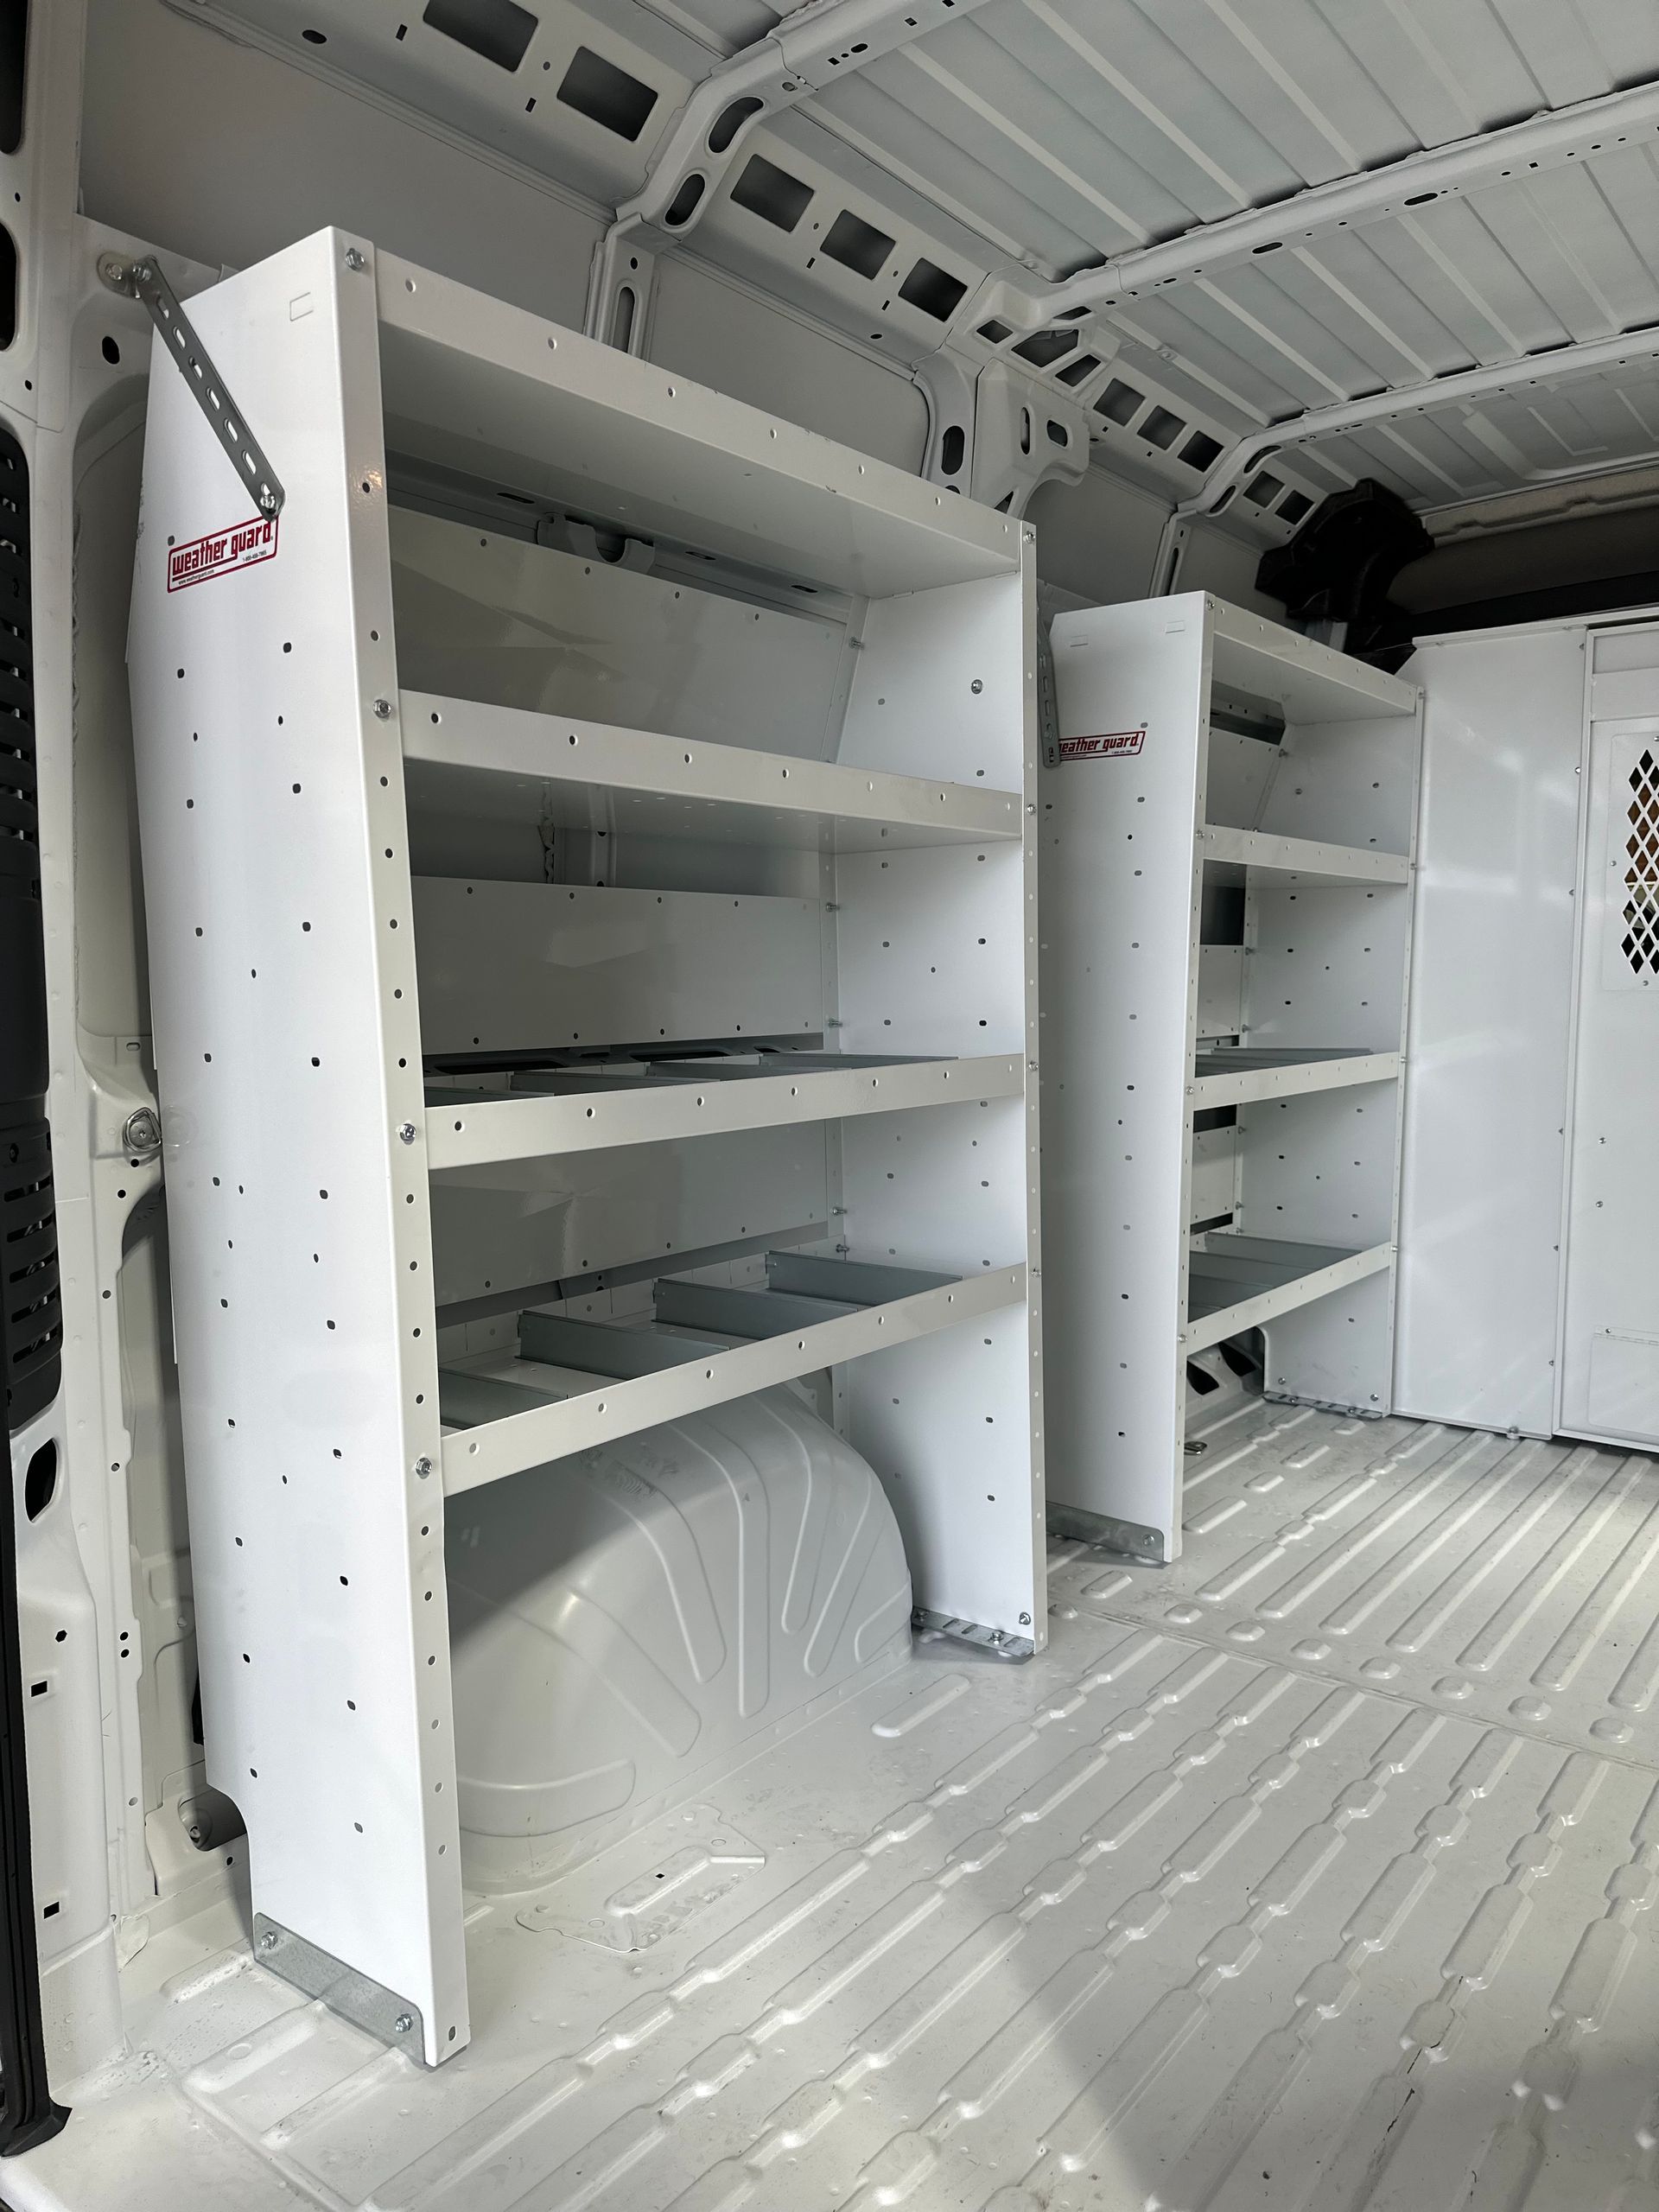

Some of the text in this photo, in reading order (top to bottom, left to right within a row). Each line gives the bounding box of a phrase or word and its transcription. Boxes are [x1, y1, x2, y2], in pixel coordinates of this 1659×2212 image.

[173, 521, 271, 576] weather guard
[1058, 733, 1139, 753] eather guard
